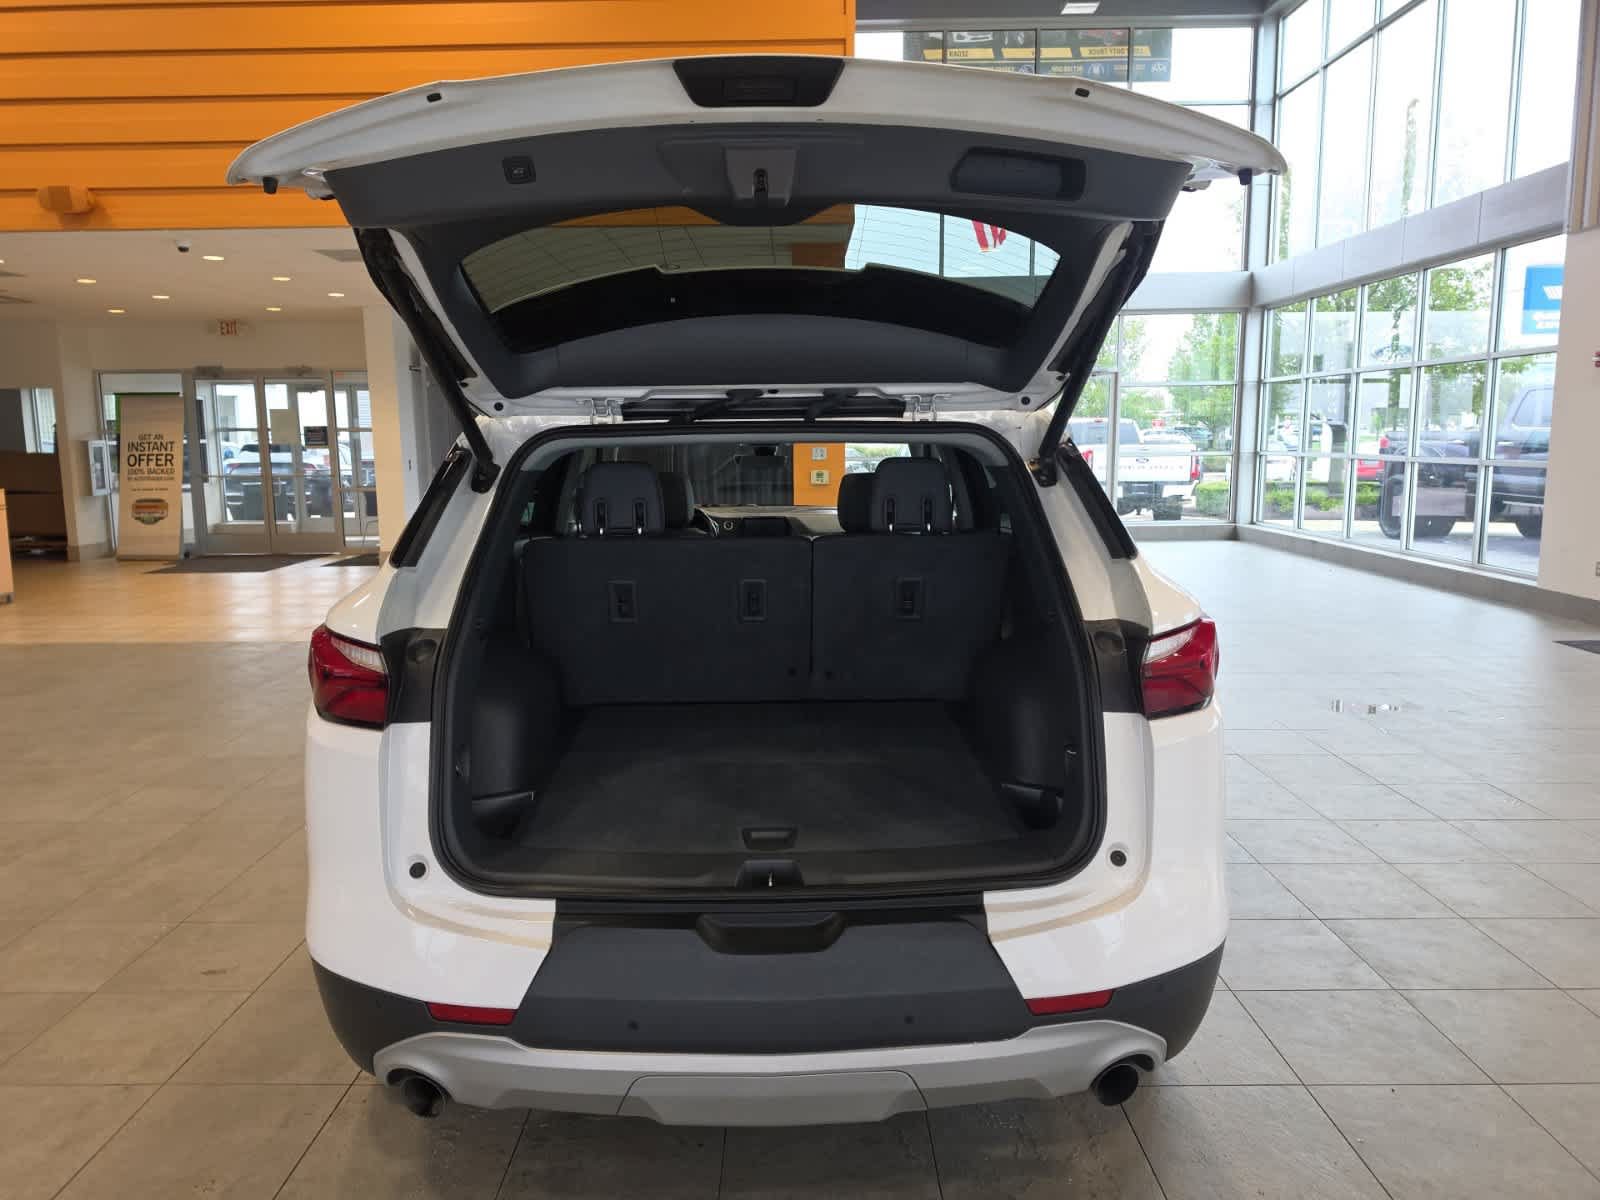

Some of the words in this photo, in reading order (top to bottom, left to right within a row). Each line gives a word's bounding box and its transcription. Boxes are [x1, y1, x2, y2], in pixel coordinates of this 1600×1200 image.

[220, 321, 238, 336] EXIT
[138, 433, 152, 441] GET
[153, 433, 164, 441] AN
[127, 441, 175, 452] INSTANT
[127, 453, 175, 467] OFFER
